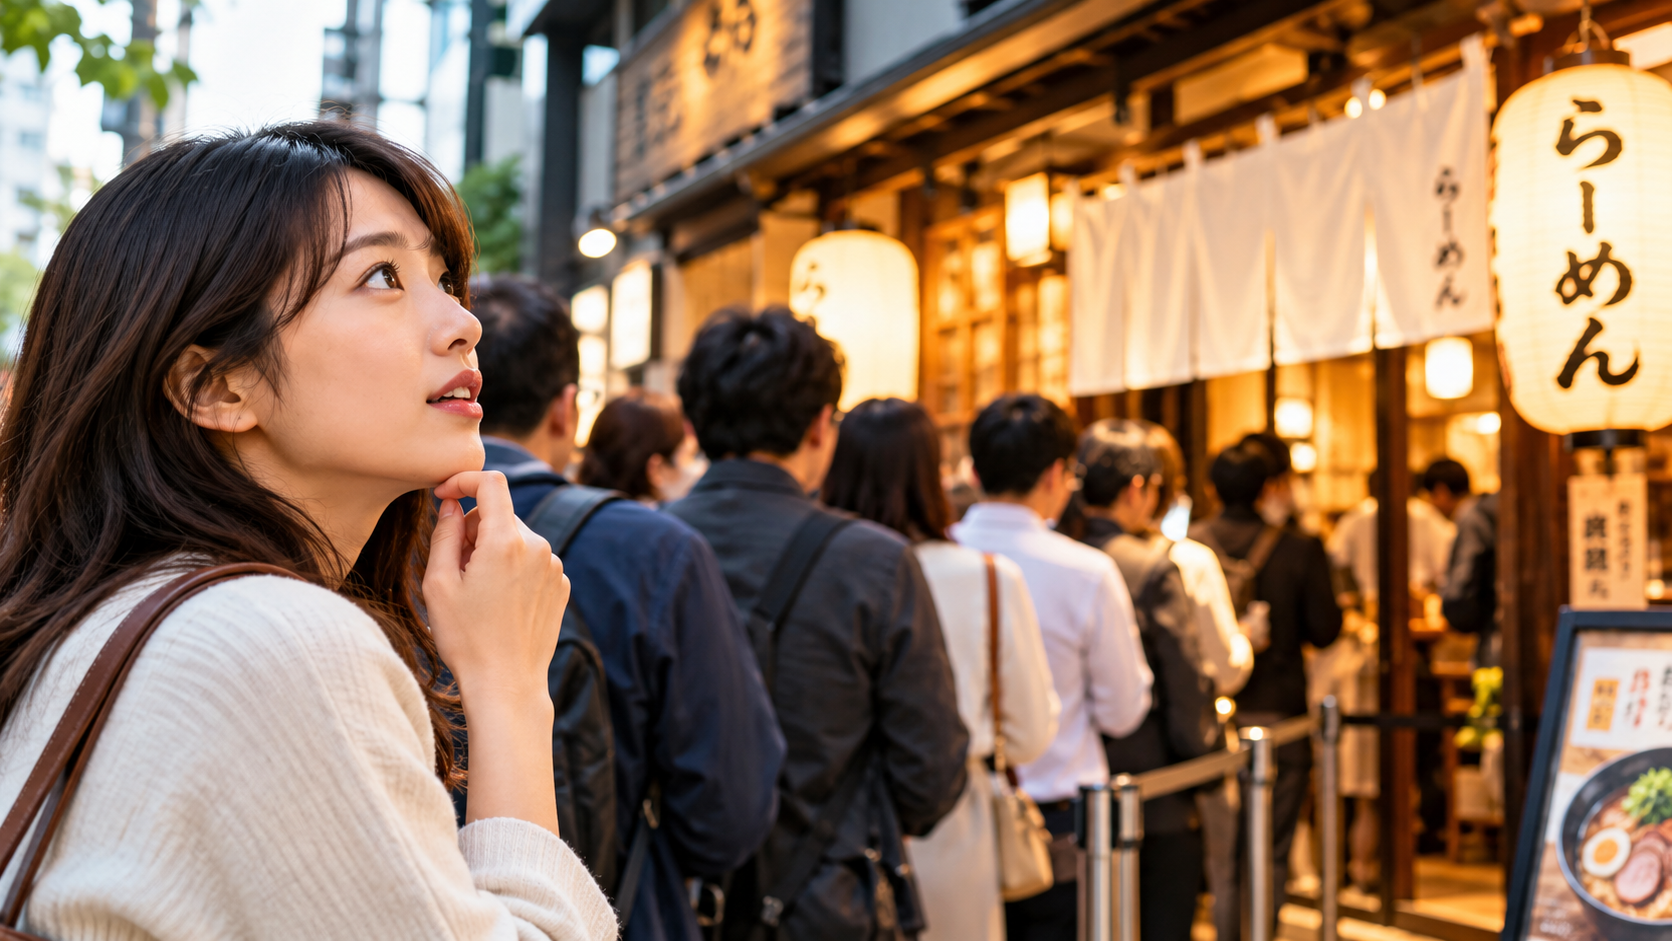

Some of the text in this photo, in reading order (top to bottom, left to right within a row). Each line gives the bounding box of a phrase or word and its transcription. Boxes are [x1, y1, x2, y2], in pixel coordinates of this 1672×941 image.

[1434, 166, 1468, 311] らーめん
[1556, 98, 1640, 390] らーめん
